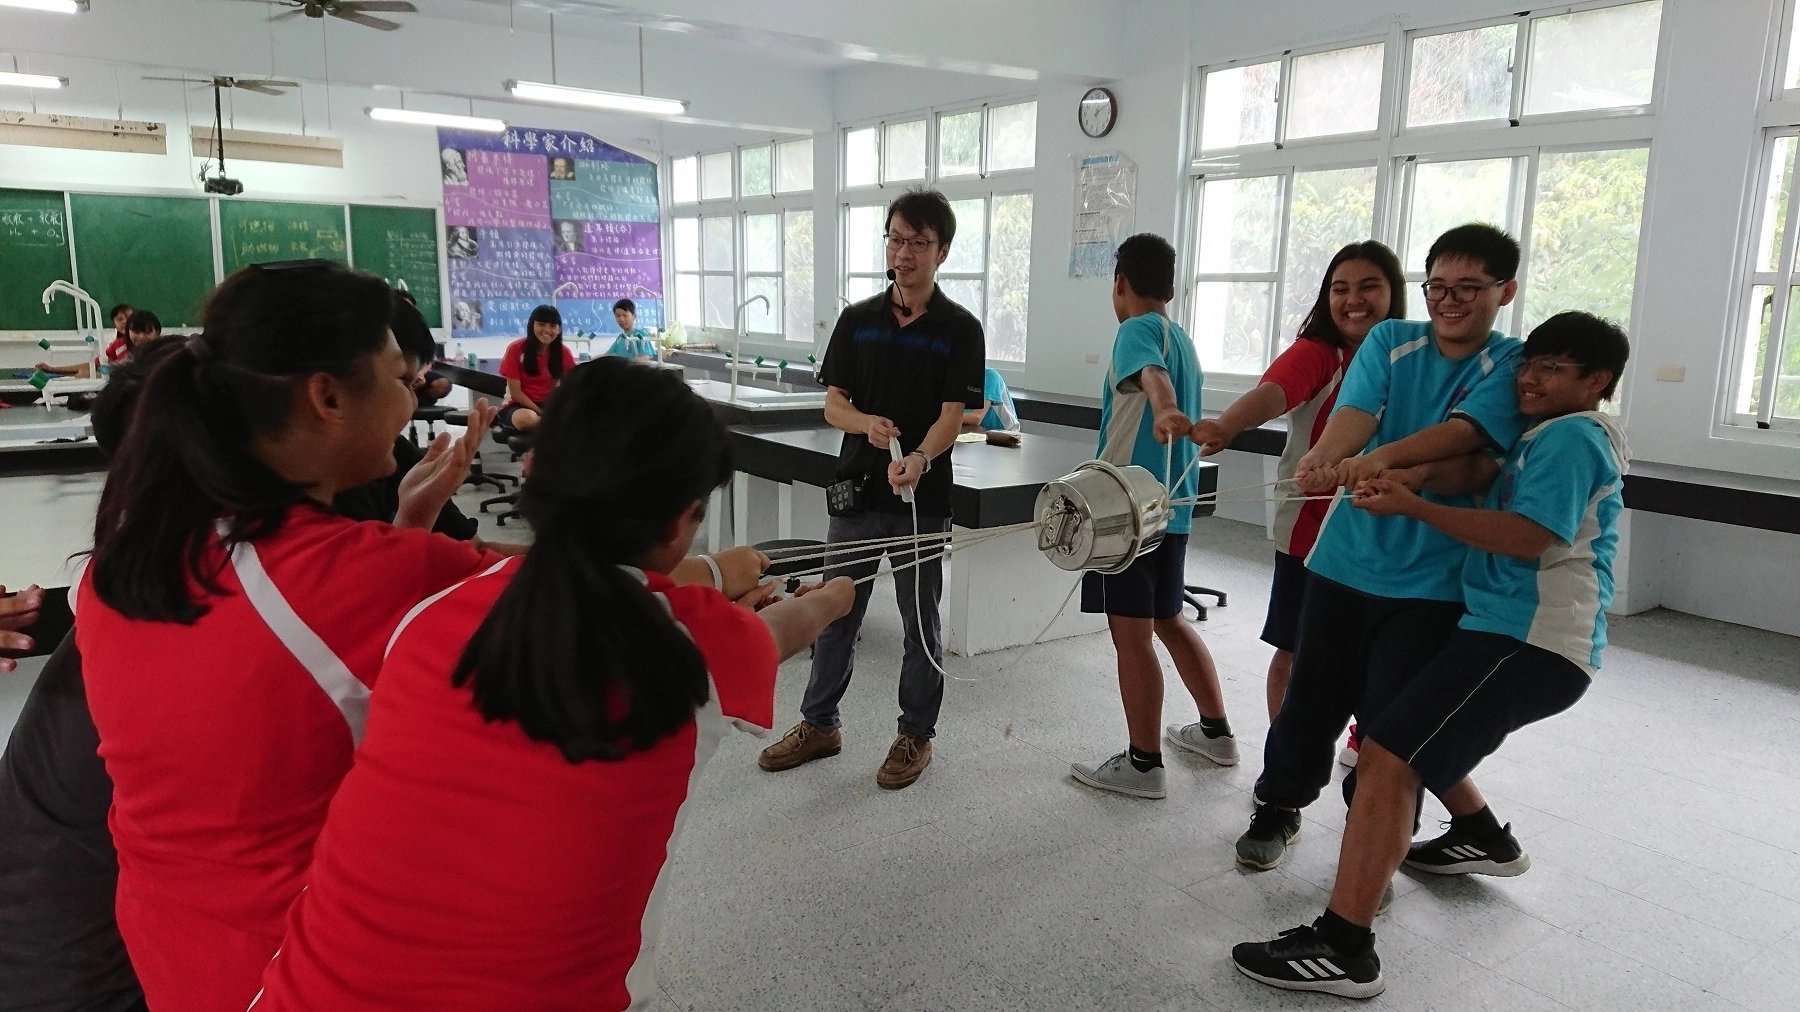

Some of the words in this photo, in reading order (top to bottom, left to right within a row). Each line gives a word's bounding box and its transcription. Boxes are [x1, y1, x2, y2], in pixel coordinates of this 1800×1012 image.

[503, 129, 595, 154] 科學家介紹
[480, 229, 499, 240] 牛頓
[487, 301, 530, 313] 愛因斯坦
